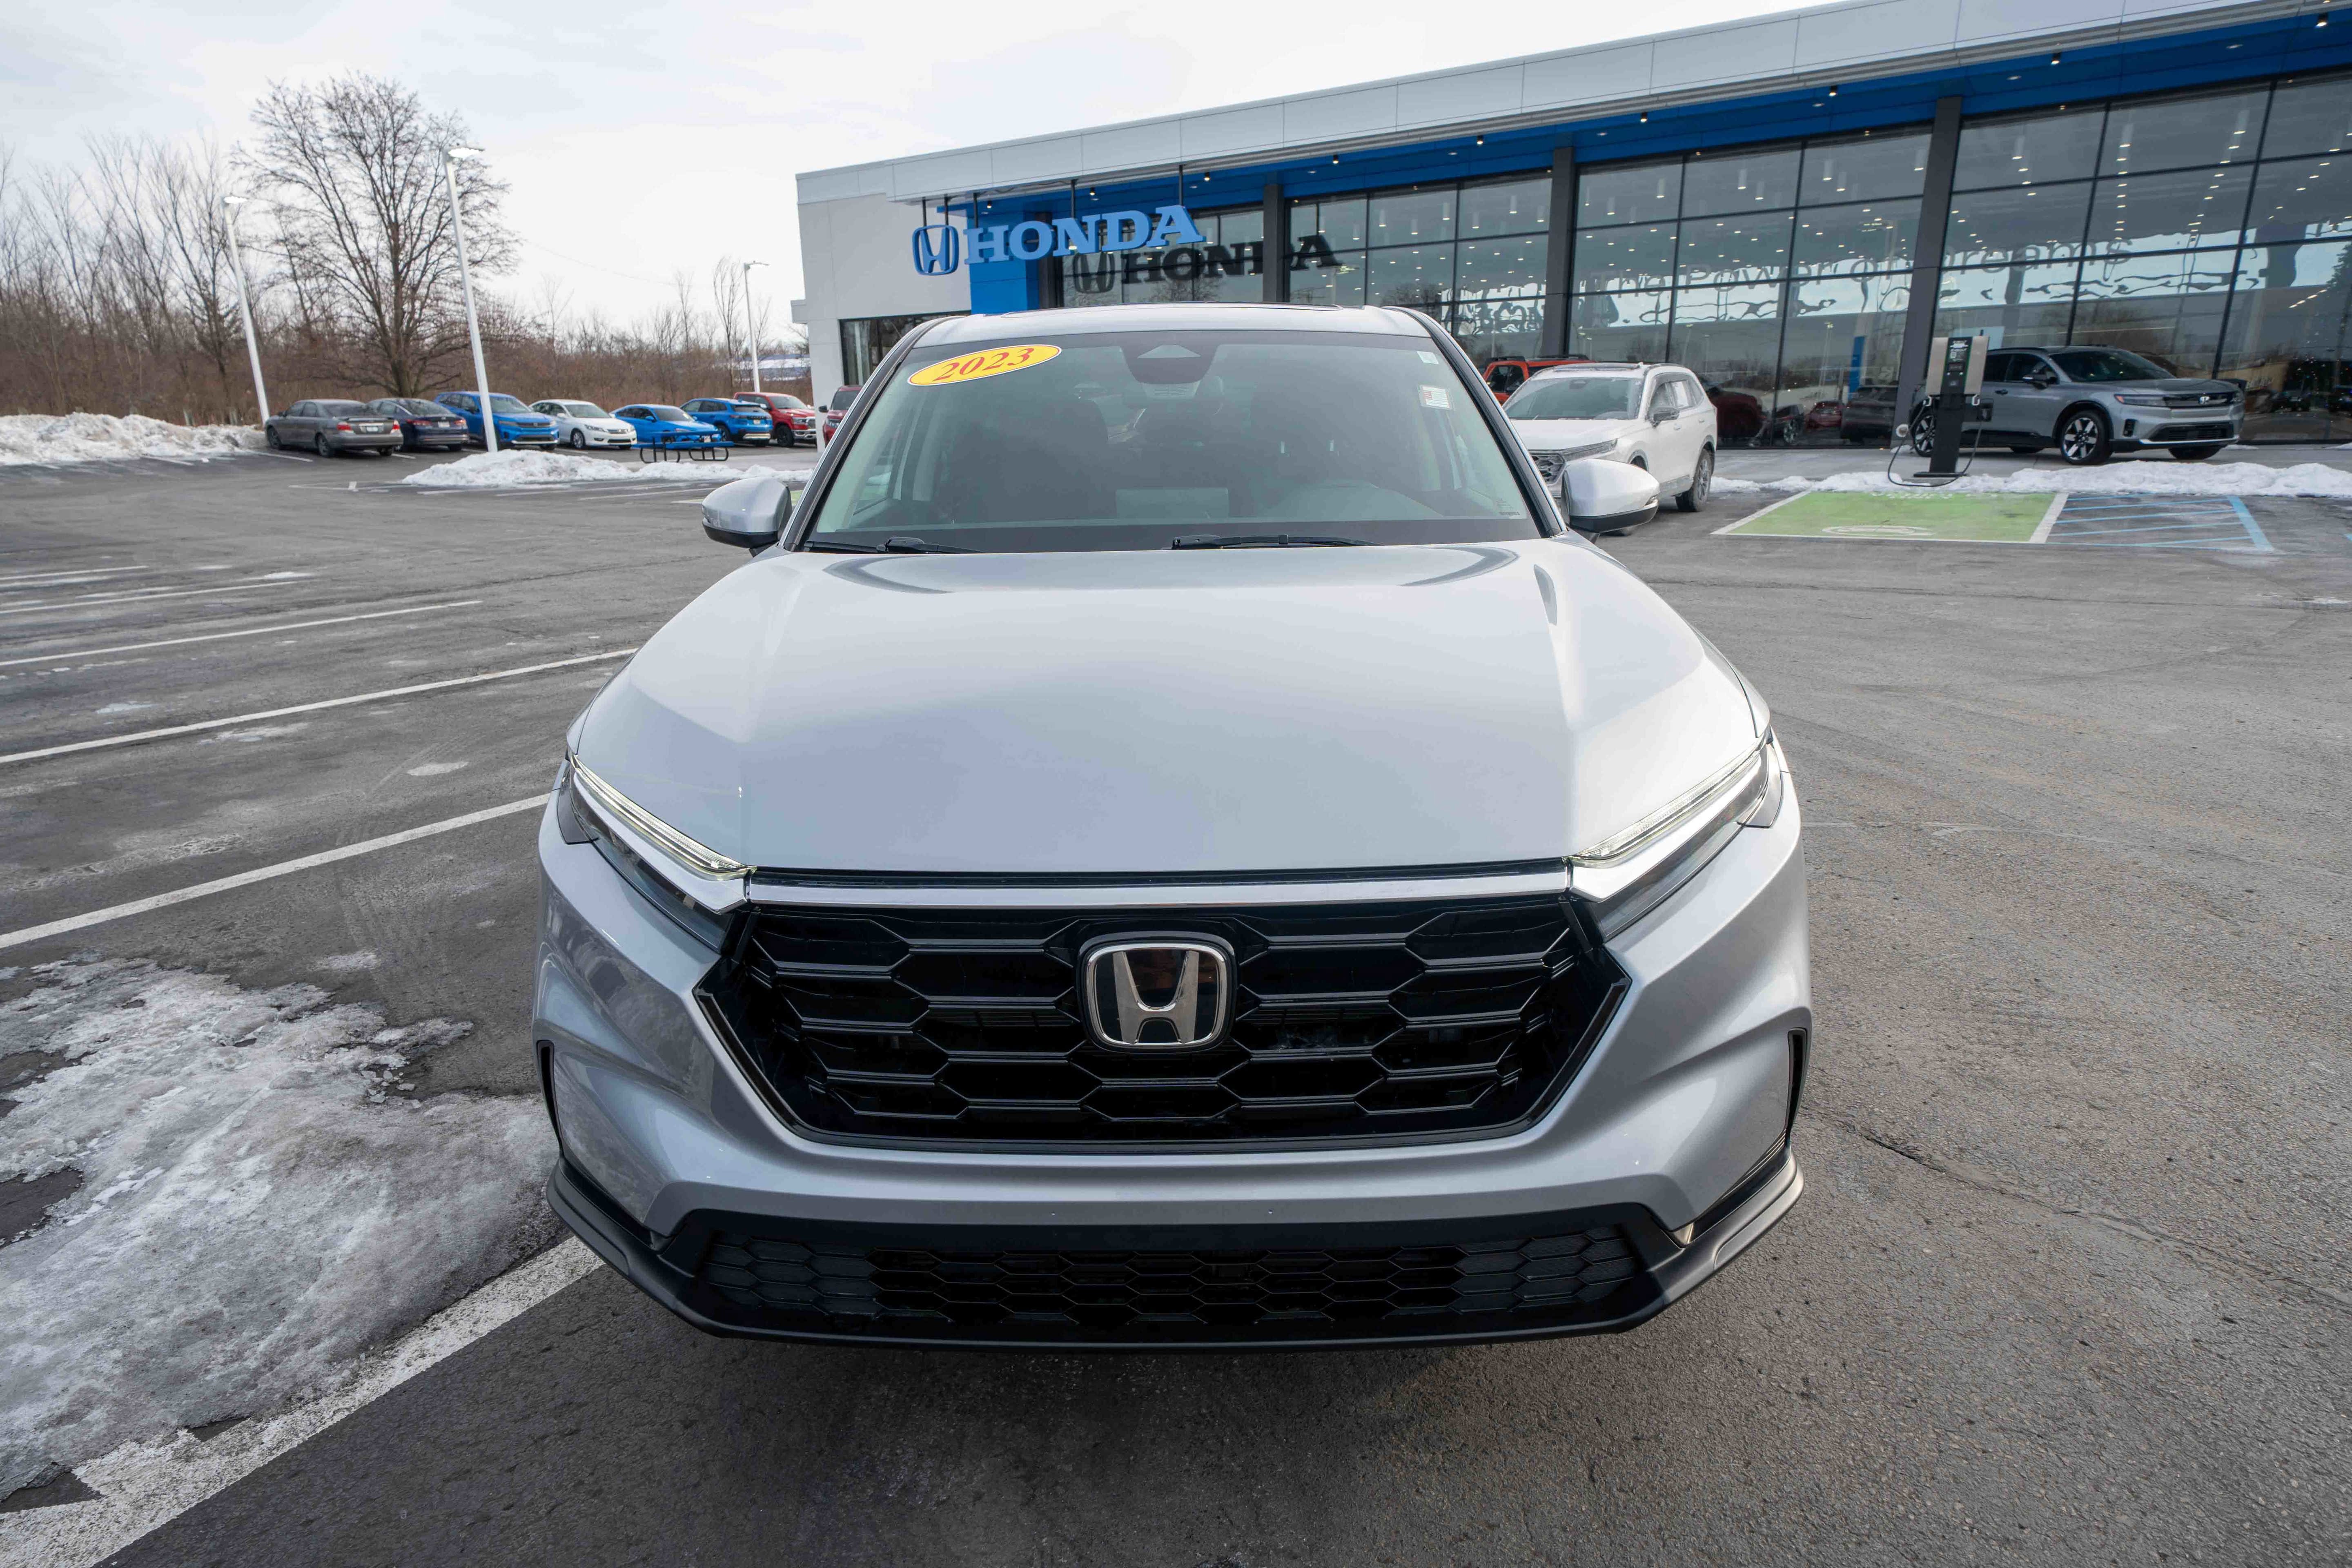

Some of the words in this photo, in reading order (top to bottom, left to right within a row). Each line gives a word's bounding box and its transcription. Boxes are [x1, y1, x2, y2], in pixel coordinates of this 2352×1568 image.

[963, 205, 1206, 265] HONDA
[1685, 261, 1832, 294] Power
[932, 348, 1034, 382] 2023
